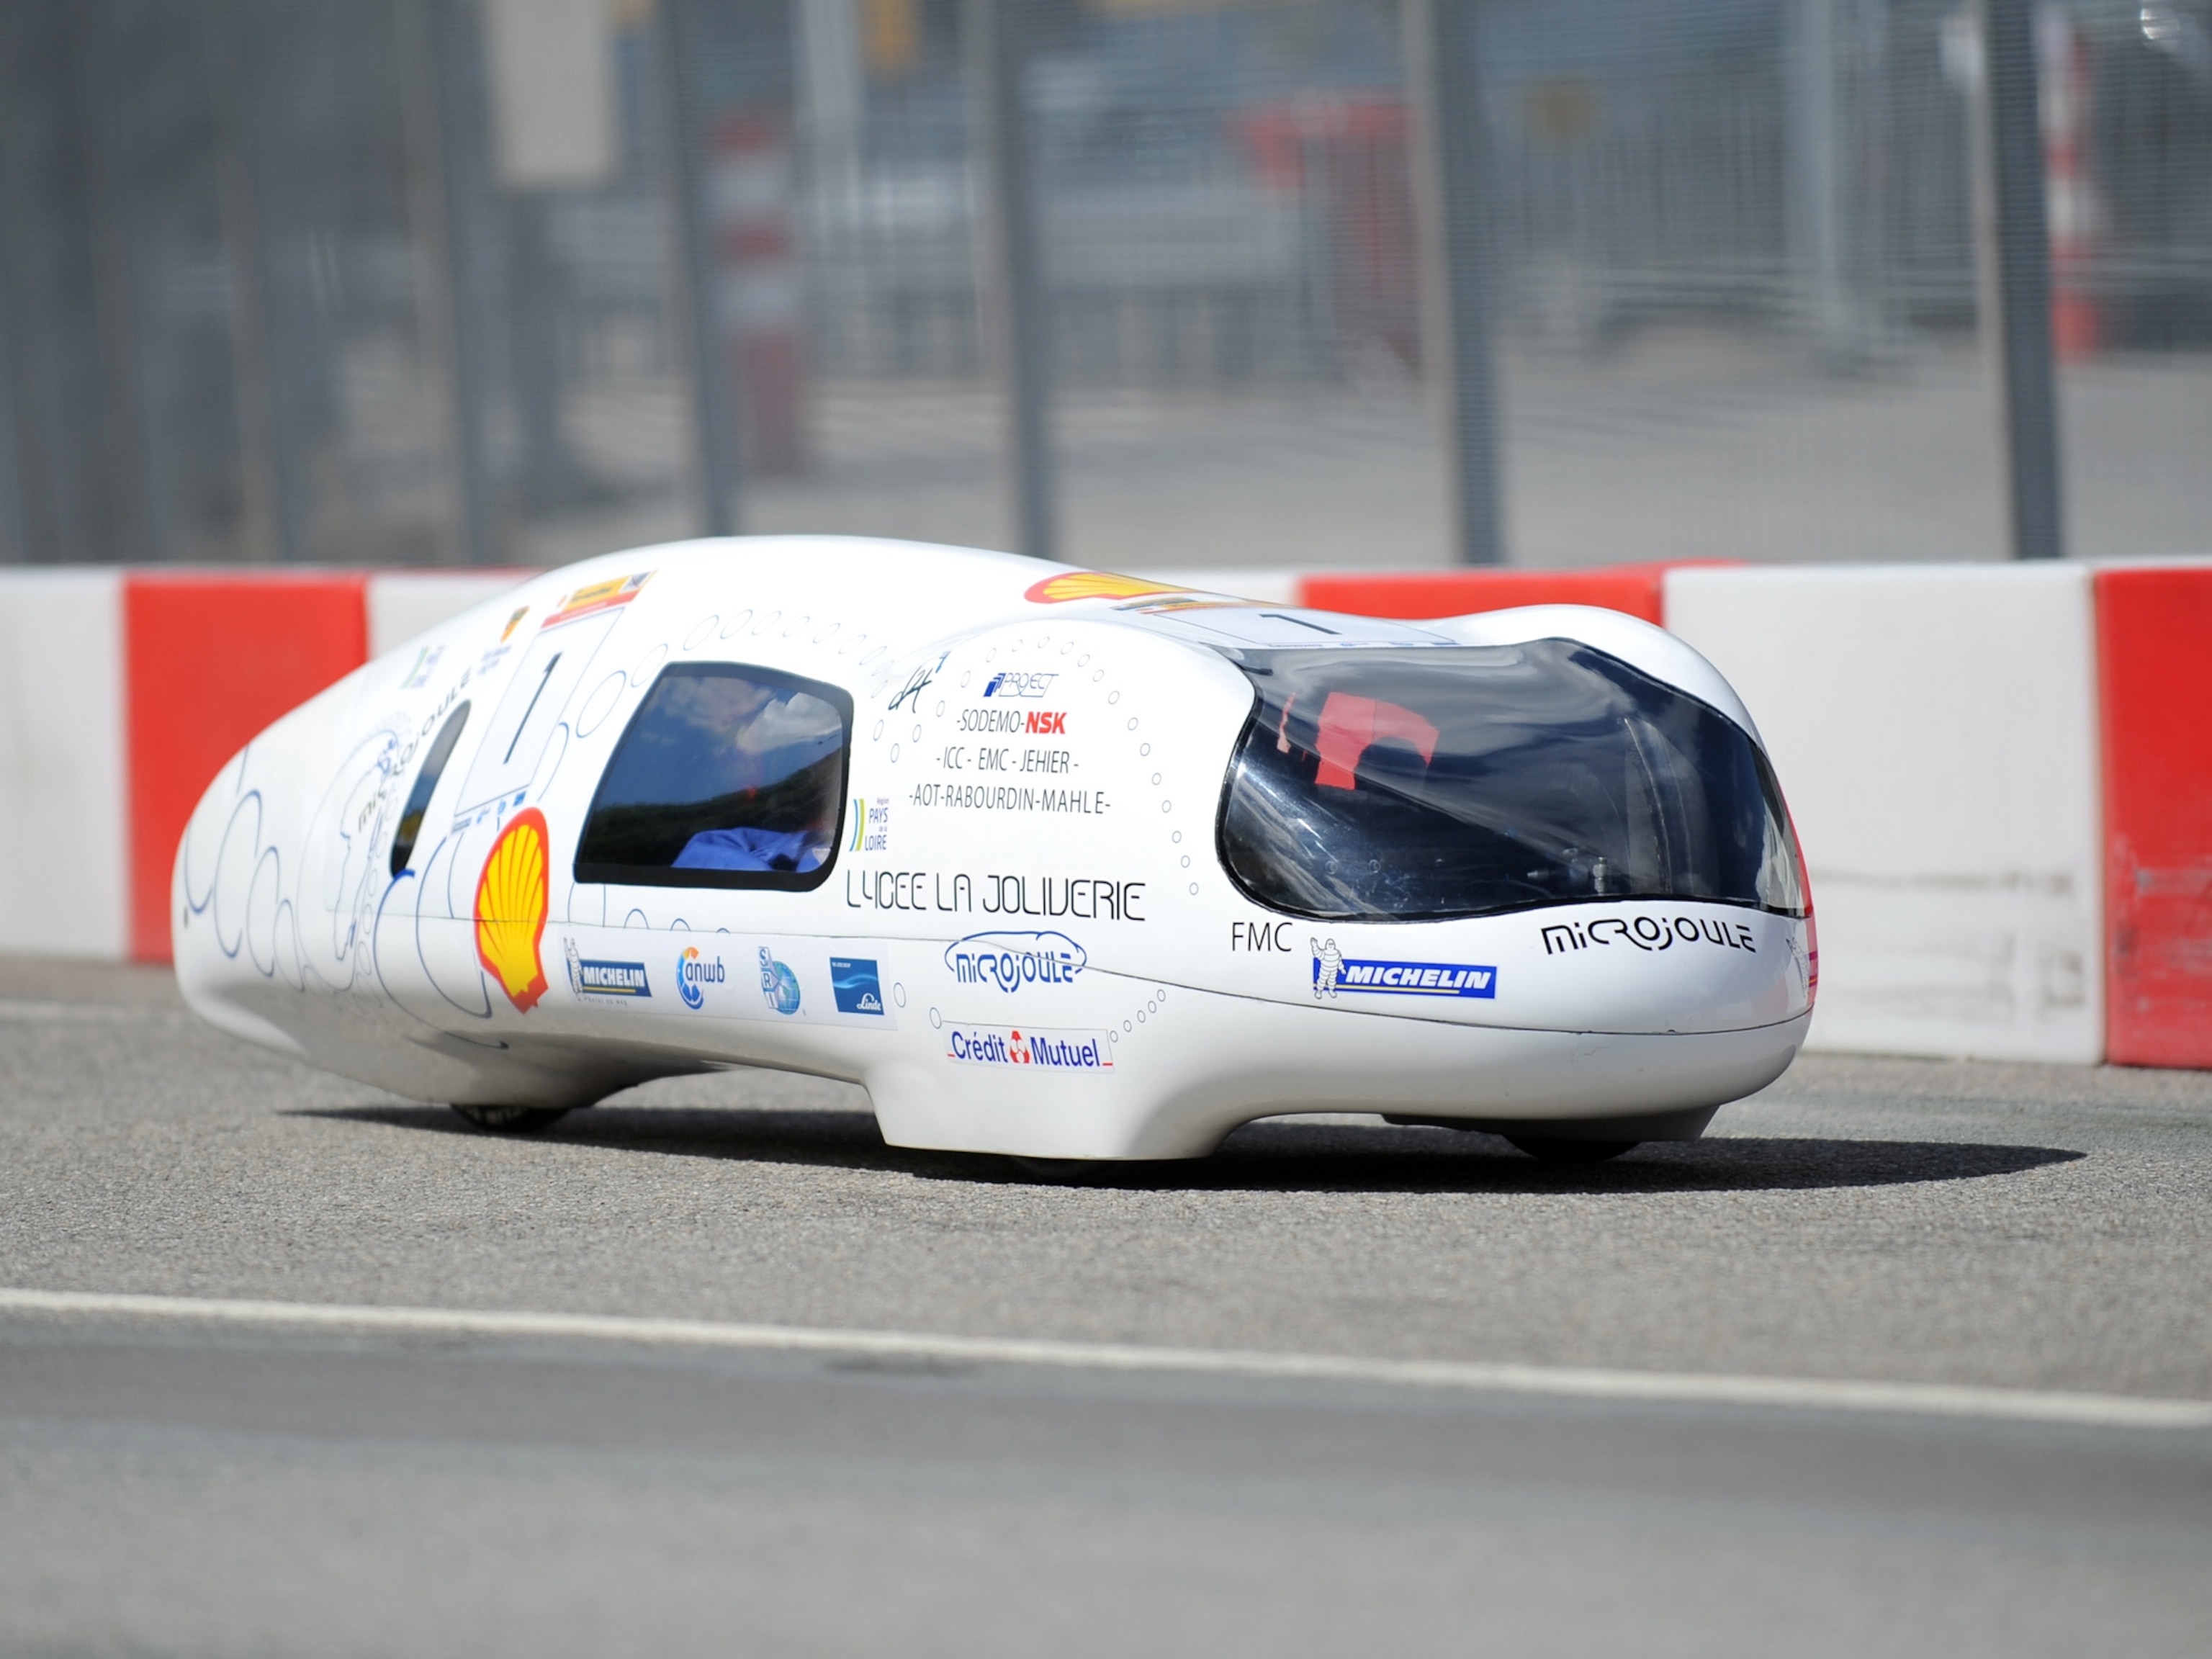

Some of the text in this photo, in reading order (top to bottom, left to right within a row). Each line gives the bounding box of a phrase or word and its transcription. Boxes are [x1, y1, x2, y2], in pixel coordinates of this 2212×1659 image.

[868, 807, 889, 824] PAYS
[865, 834, 887, 851] LOIRE
[847, 869, 1146, 921] LYCEE LA JOLIVERIE
[1232, 922, 1293, 952] FMC
[583, 966, 646, 987] MICHELIN
[685, 956, 725, 984] anwb
[1344, 966, 1492, 989] MICHELIN
[855, 992, 881, 1011] Linde
[950, 1031, 1101, 1068] Crédit Mutuel
